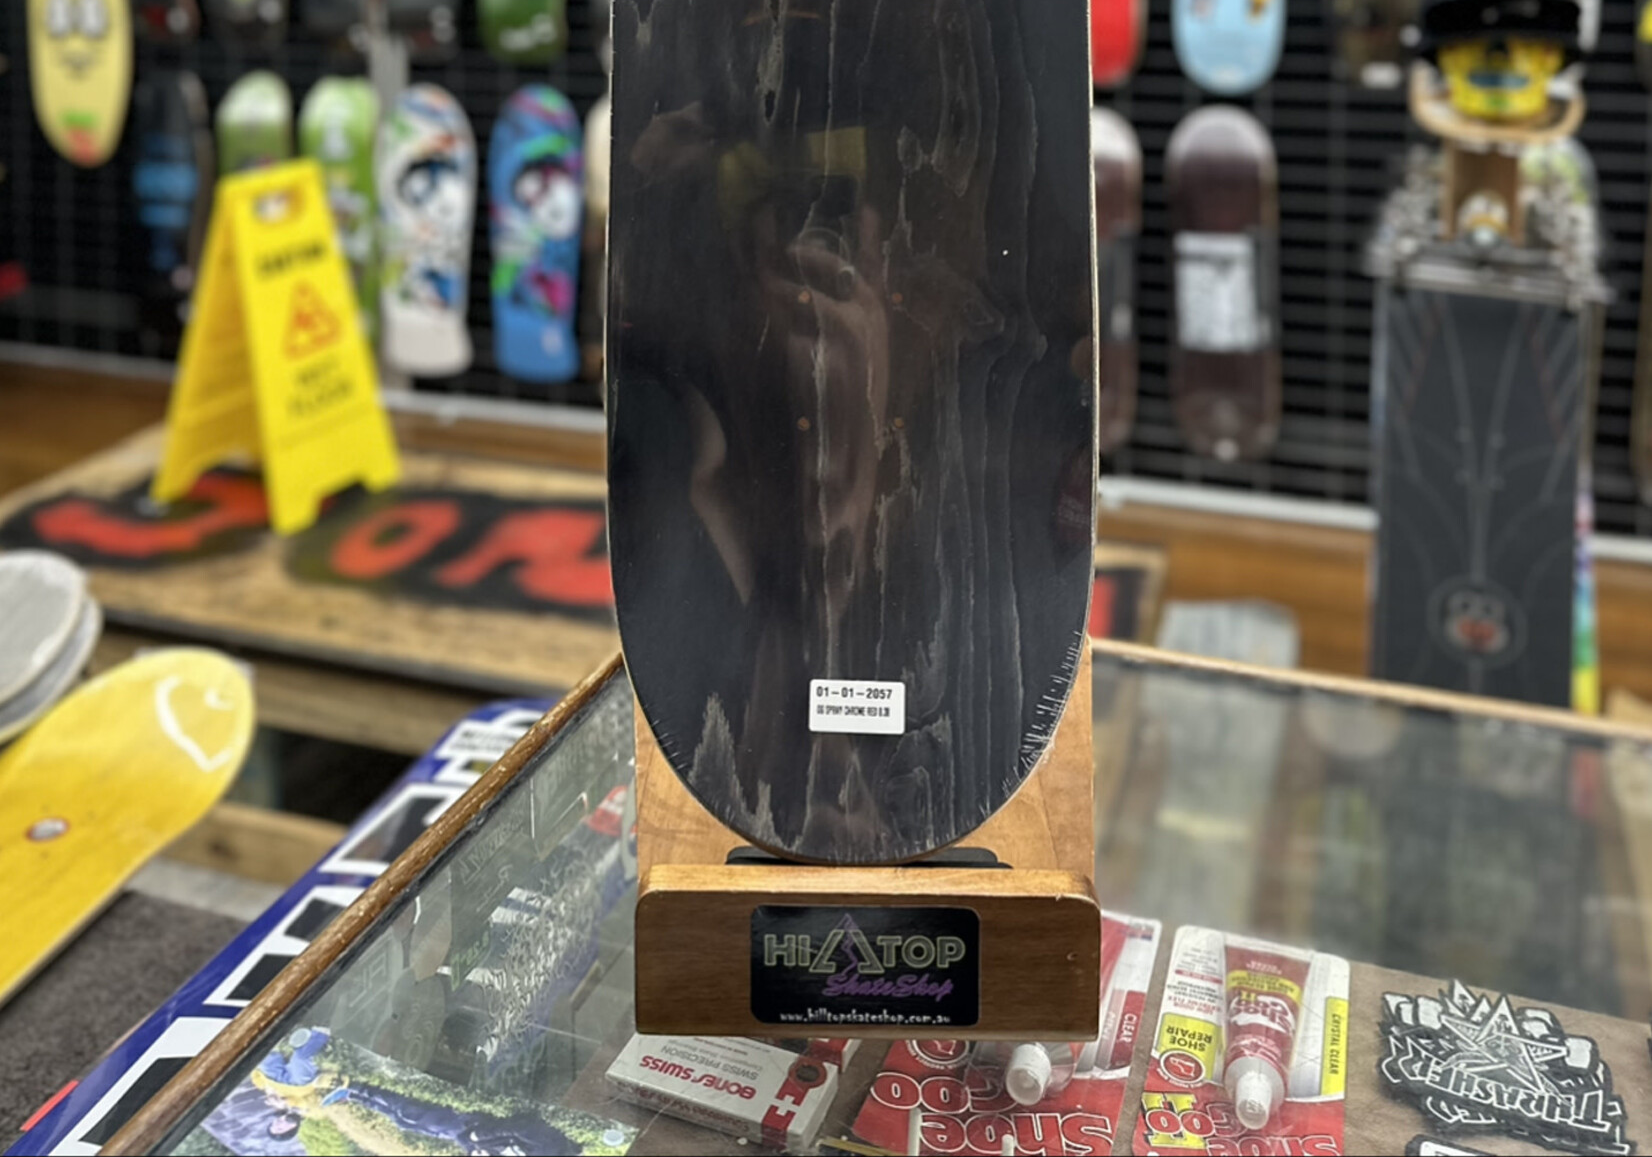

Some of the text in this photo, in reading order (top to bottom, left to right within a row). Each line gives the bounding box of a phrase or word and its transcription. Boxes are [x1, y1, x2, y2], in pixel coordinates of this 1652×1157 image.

[1119, 1013, 1137, 1044] CLEAR
[1166, 1026, 1212, 1043] REPAIR
[1169, 1035, 1206, 1052] SHOE
[661, 1045, 721, 1069] PRECISION
[639, 1055, 695, 1080] SWISS
[721, 1063, 759, 1080] SWISS
